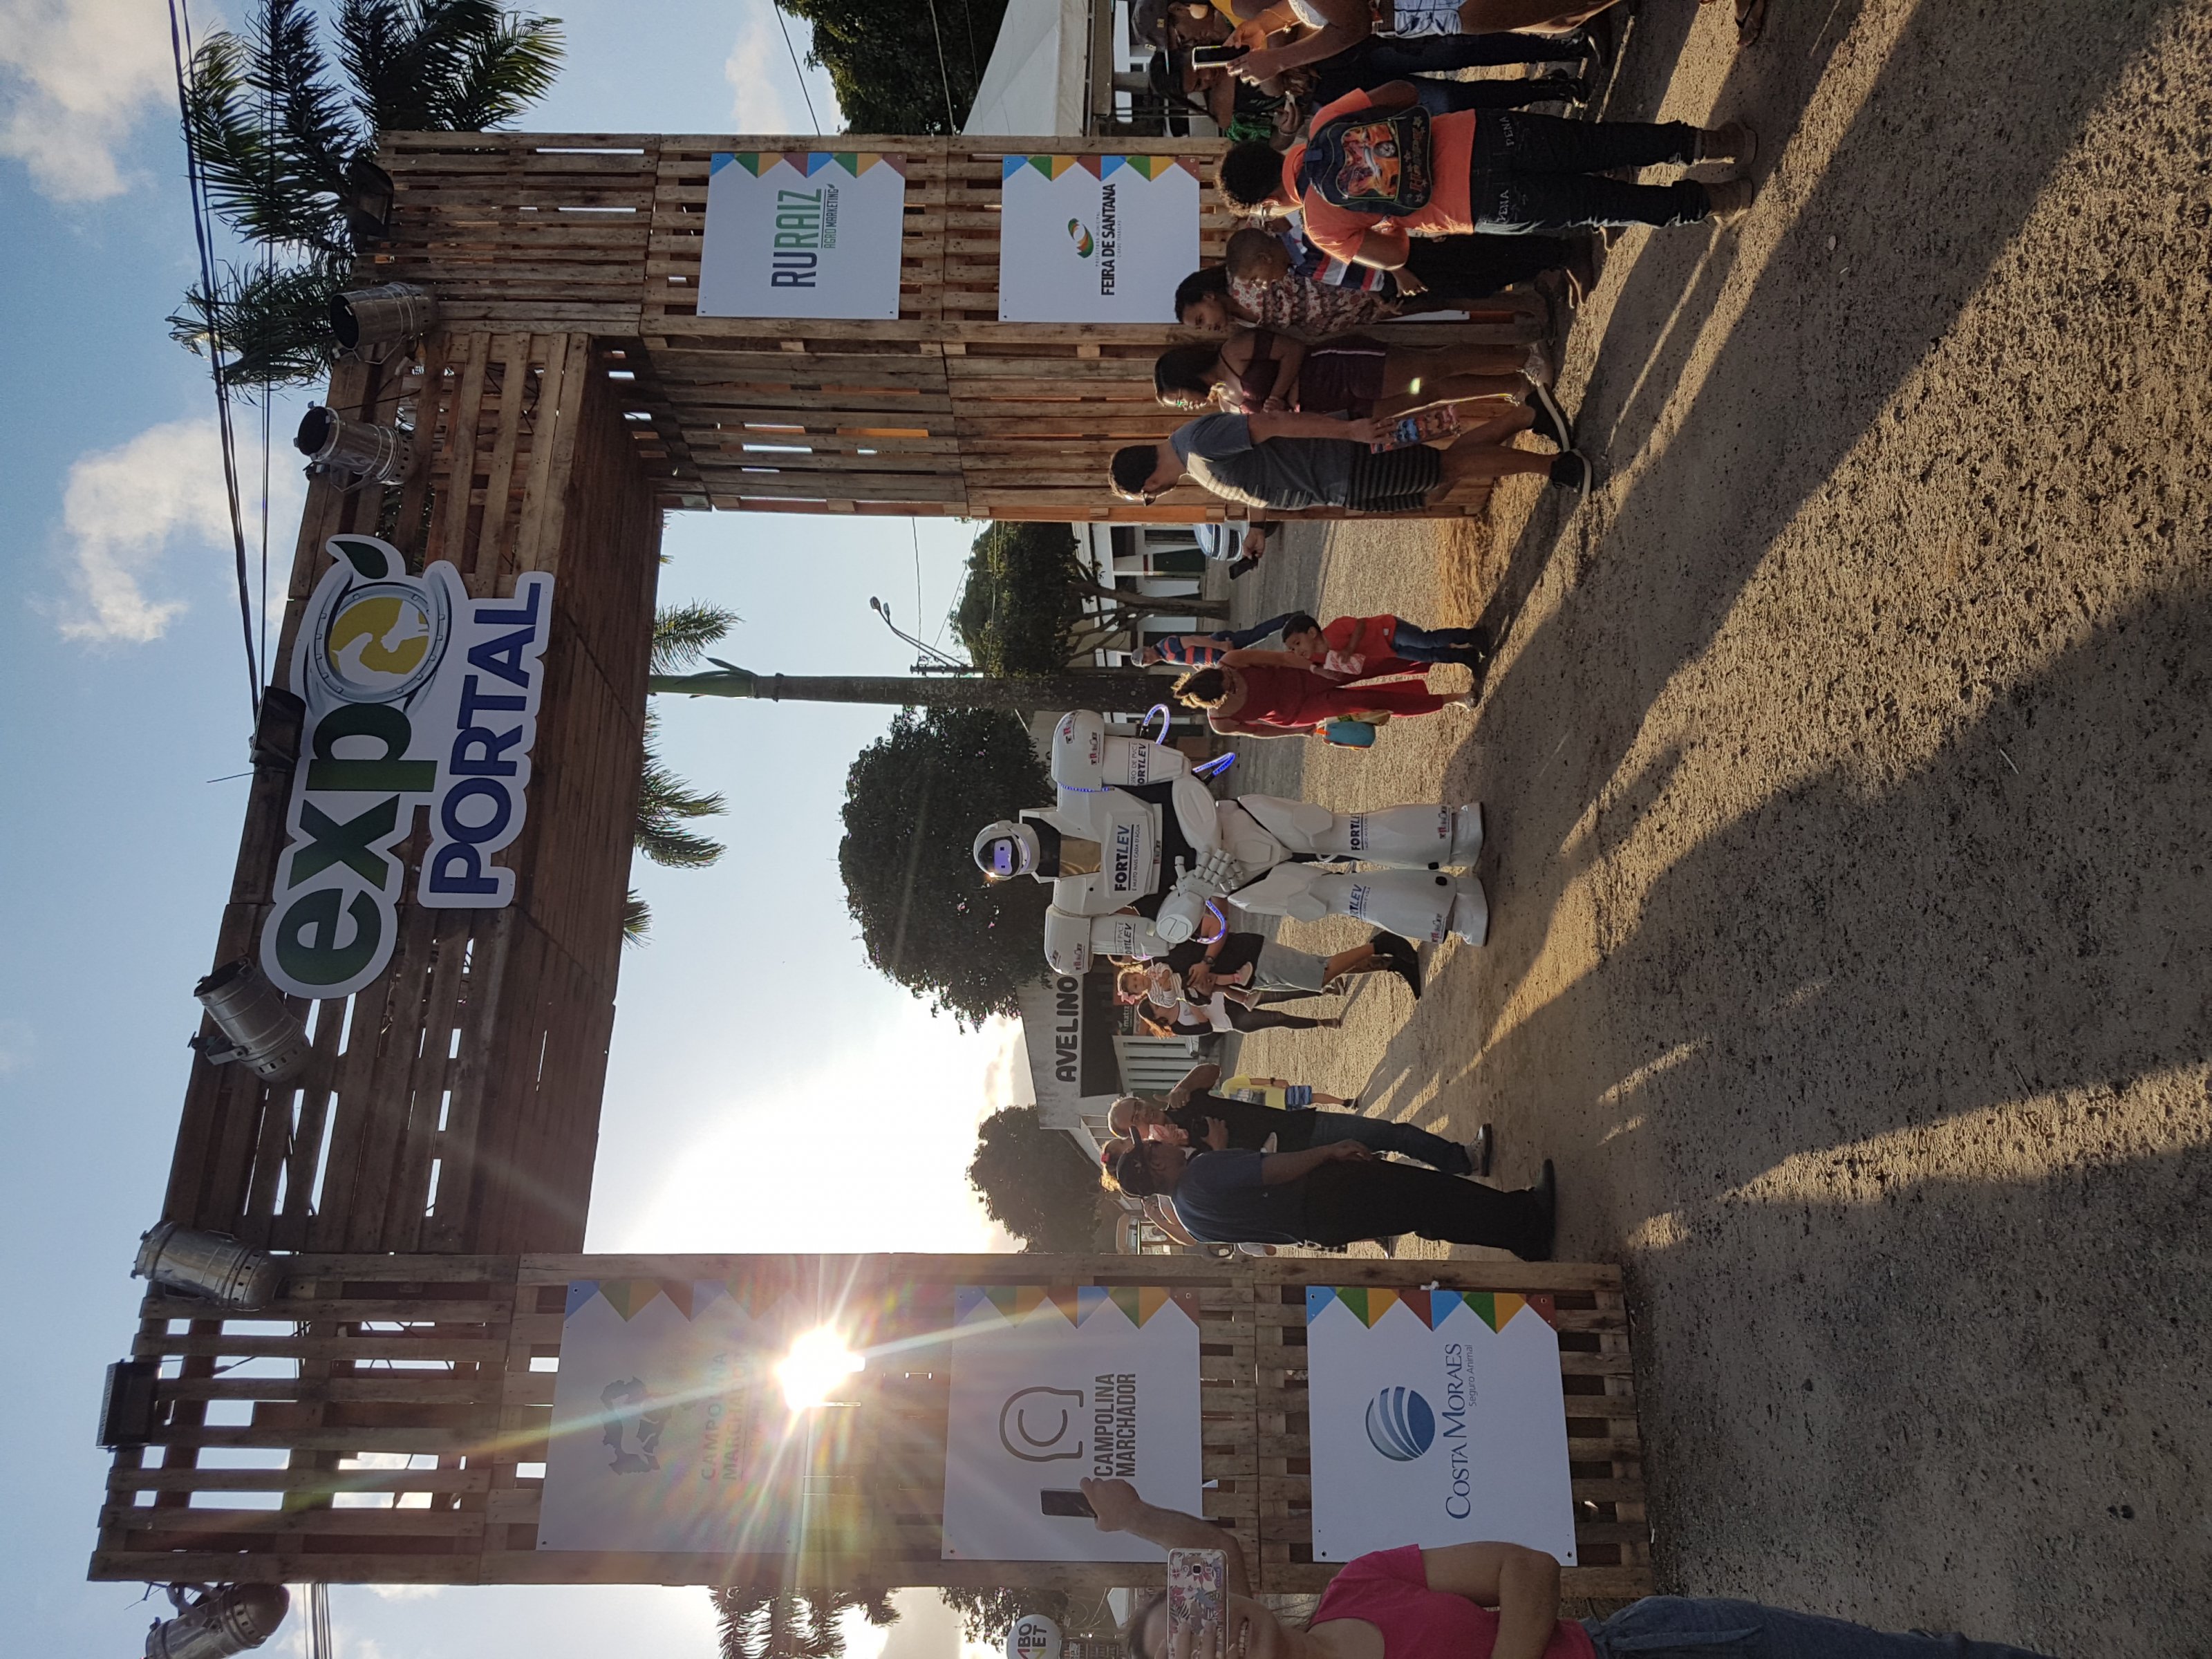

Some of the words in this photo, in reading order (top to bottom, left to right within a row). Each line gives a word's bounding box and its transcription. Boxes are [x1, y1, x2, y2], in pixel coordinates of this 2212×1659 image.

[1499, 115, 1515, 147] PENA
[825, 189, 839, 227] MARKETING
[1101, 183, 1116, 238] SANTANA
[1496, 189, 1510, 222] PENA
[771, 188, 823, 287] RURAIZ
[823, 228, 836, 249] AGRO
[1101, 241, 1116, 257] DE
[1100, 259, 1116, 296] FEIRA
[429, 582, 541, 894] PORTAL
[1137, 742, 1146, 785] ORTLEV
[1114, 825, 1130, 891] FORTLEV
[1123, 922, 1132, 954] ORTLEV
[1056, 975, 1079, 1082] AVELINO
[1465, 1344, 1474, 1374] Animal
[1441, 1342, 1466, 1438] MORAES
[1466, 1376, 1478, 1407] Seguro
[1094, 1374, 1115, 1478] CAMPOLINA
[1116, 1374, 1136, 1478] MARCHADOR
[1445, 1443, 1471, 1519] COSTA
